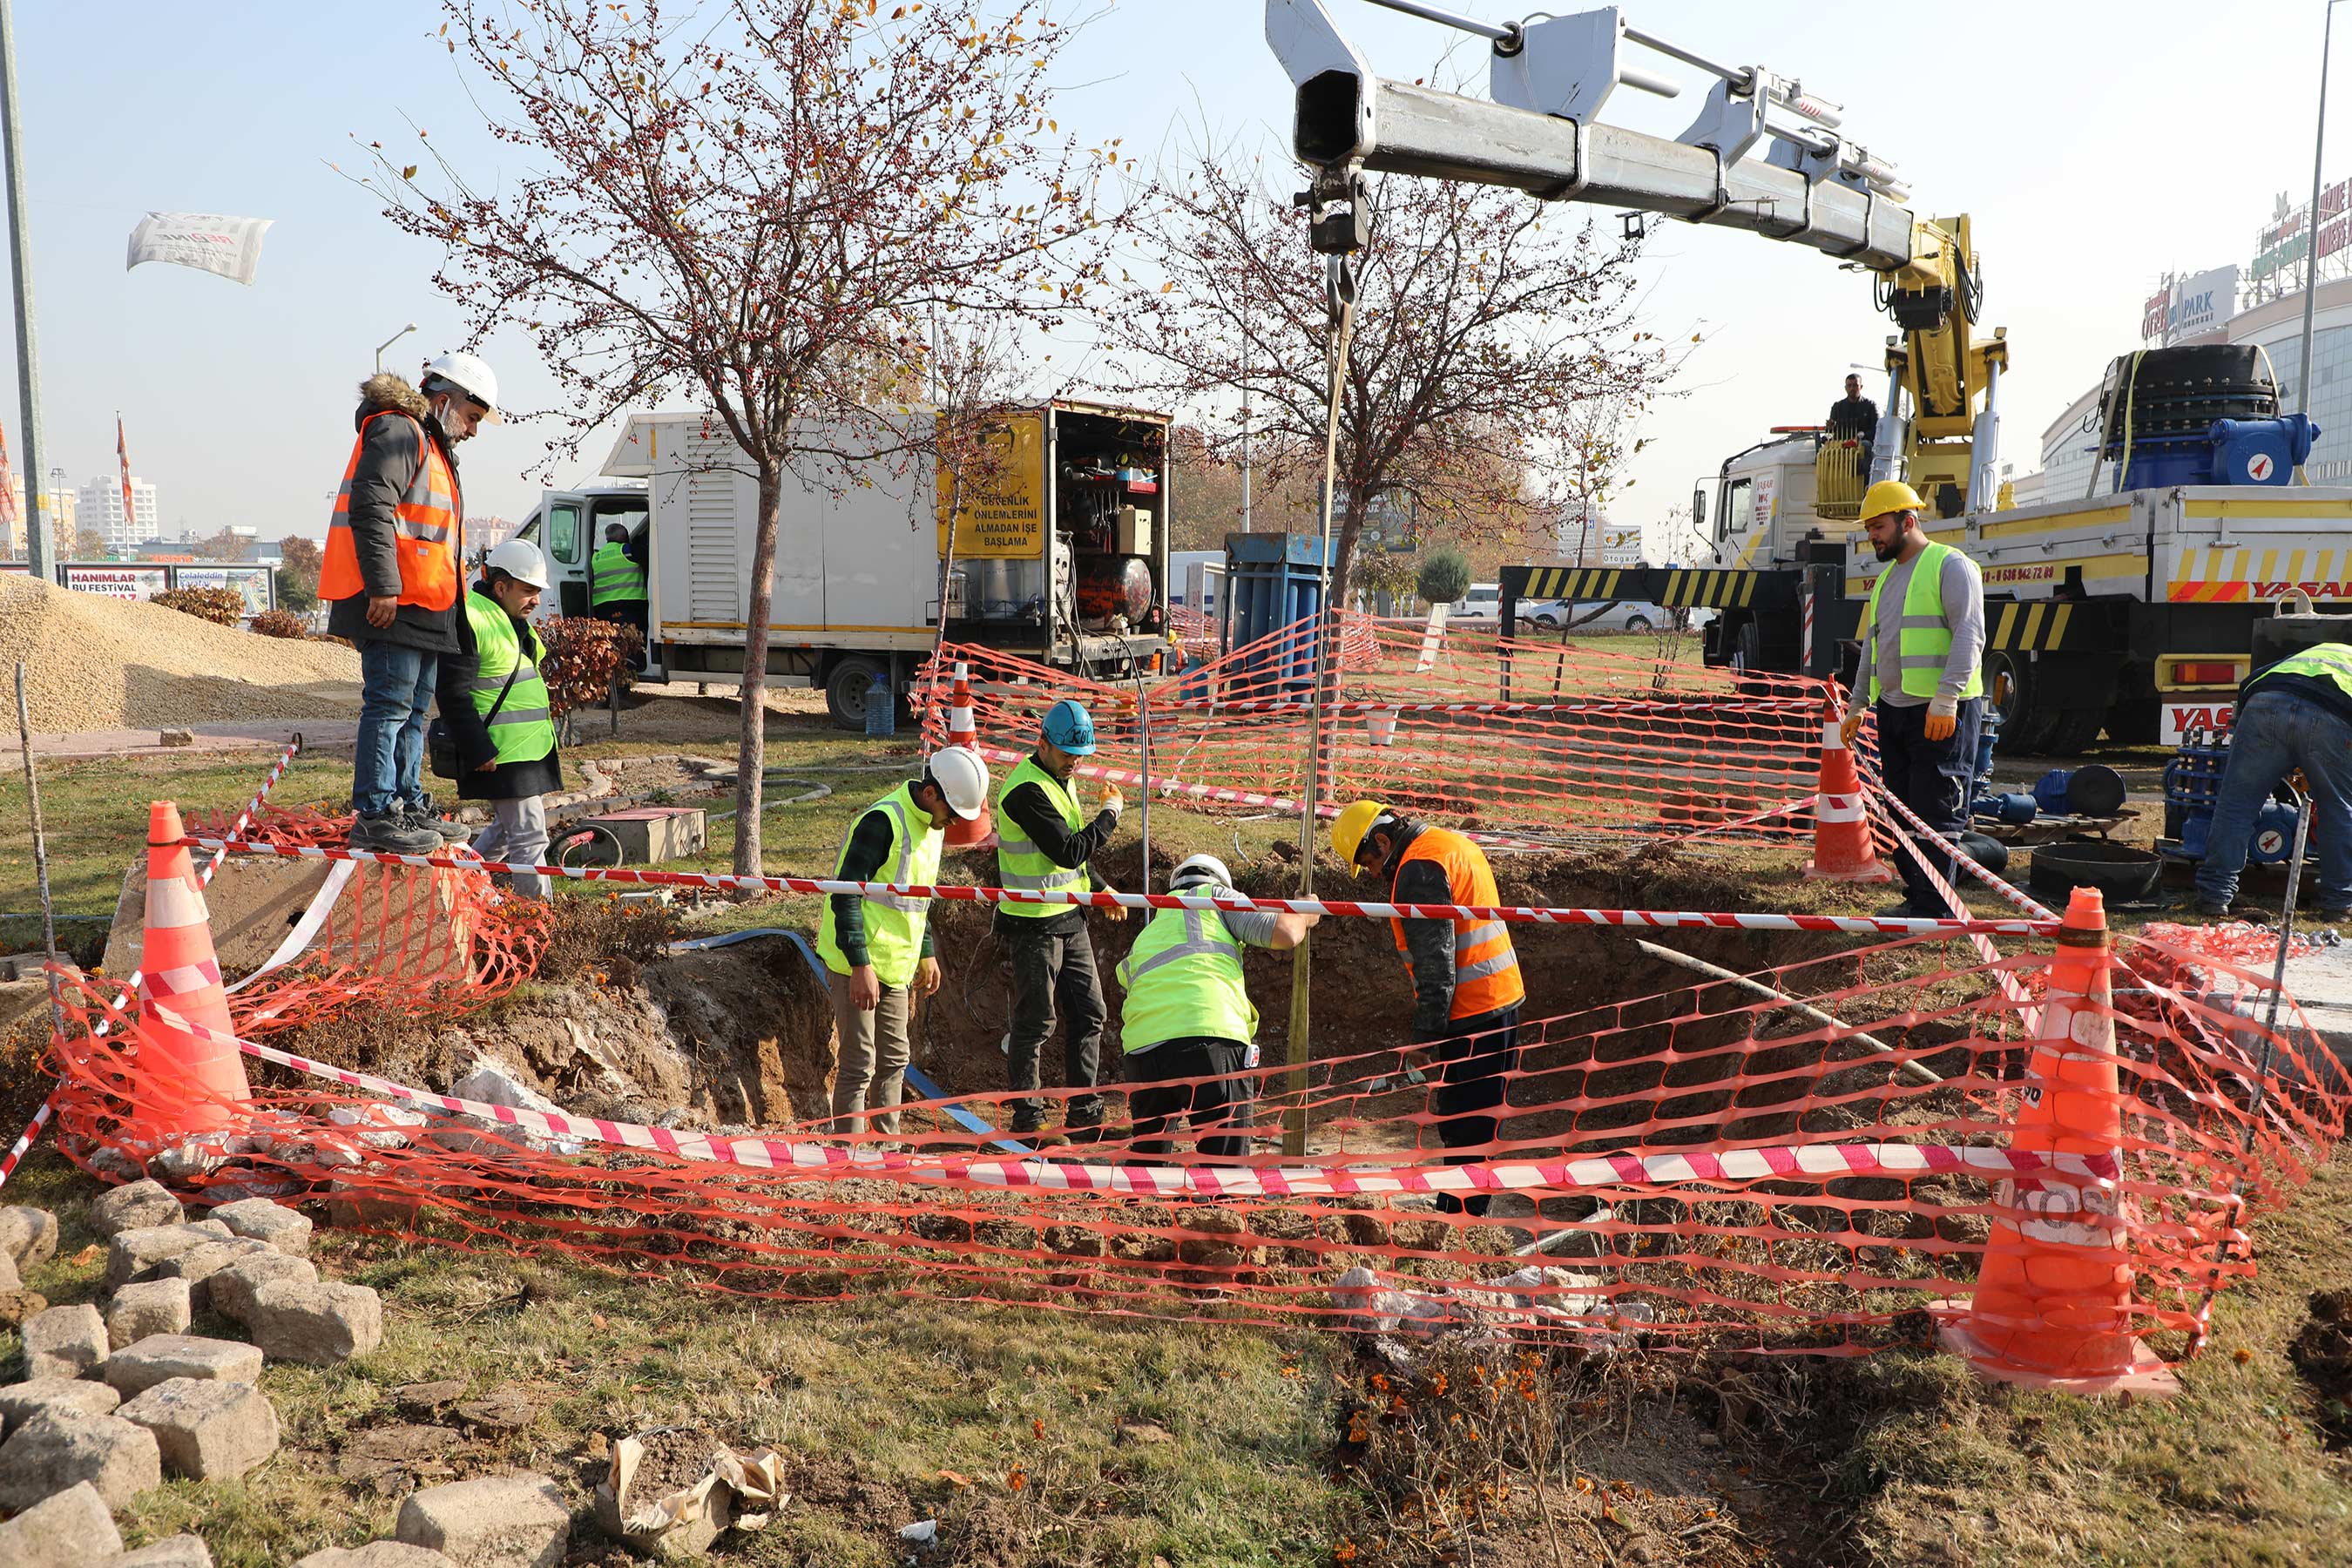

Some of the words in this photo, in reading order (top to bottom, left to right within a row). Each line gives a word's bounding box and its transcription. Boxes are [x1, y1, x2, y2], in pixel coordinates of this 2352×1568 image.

[2183, 291, 2214, 319] PARK
[974, 509, 1037, 520] ÖNLEMLERİNİ
[976, 524, 1019, 533] ALMADAN
[1022, 523, 1037, 535] İŞE
[984, 537, 1028, 549] BAŞLAMA
[1604, 554, 1634, 564] Otogar
[71, 573, 136, 583] HANIMLAR
